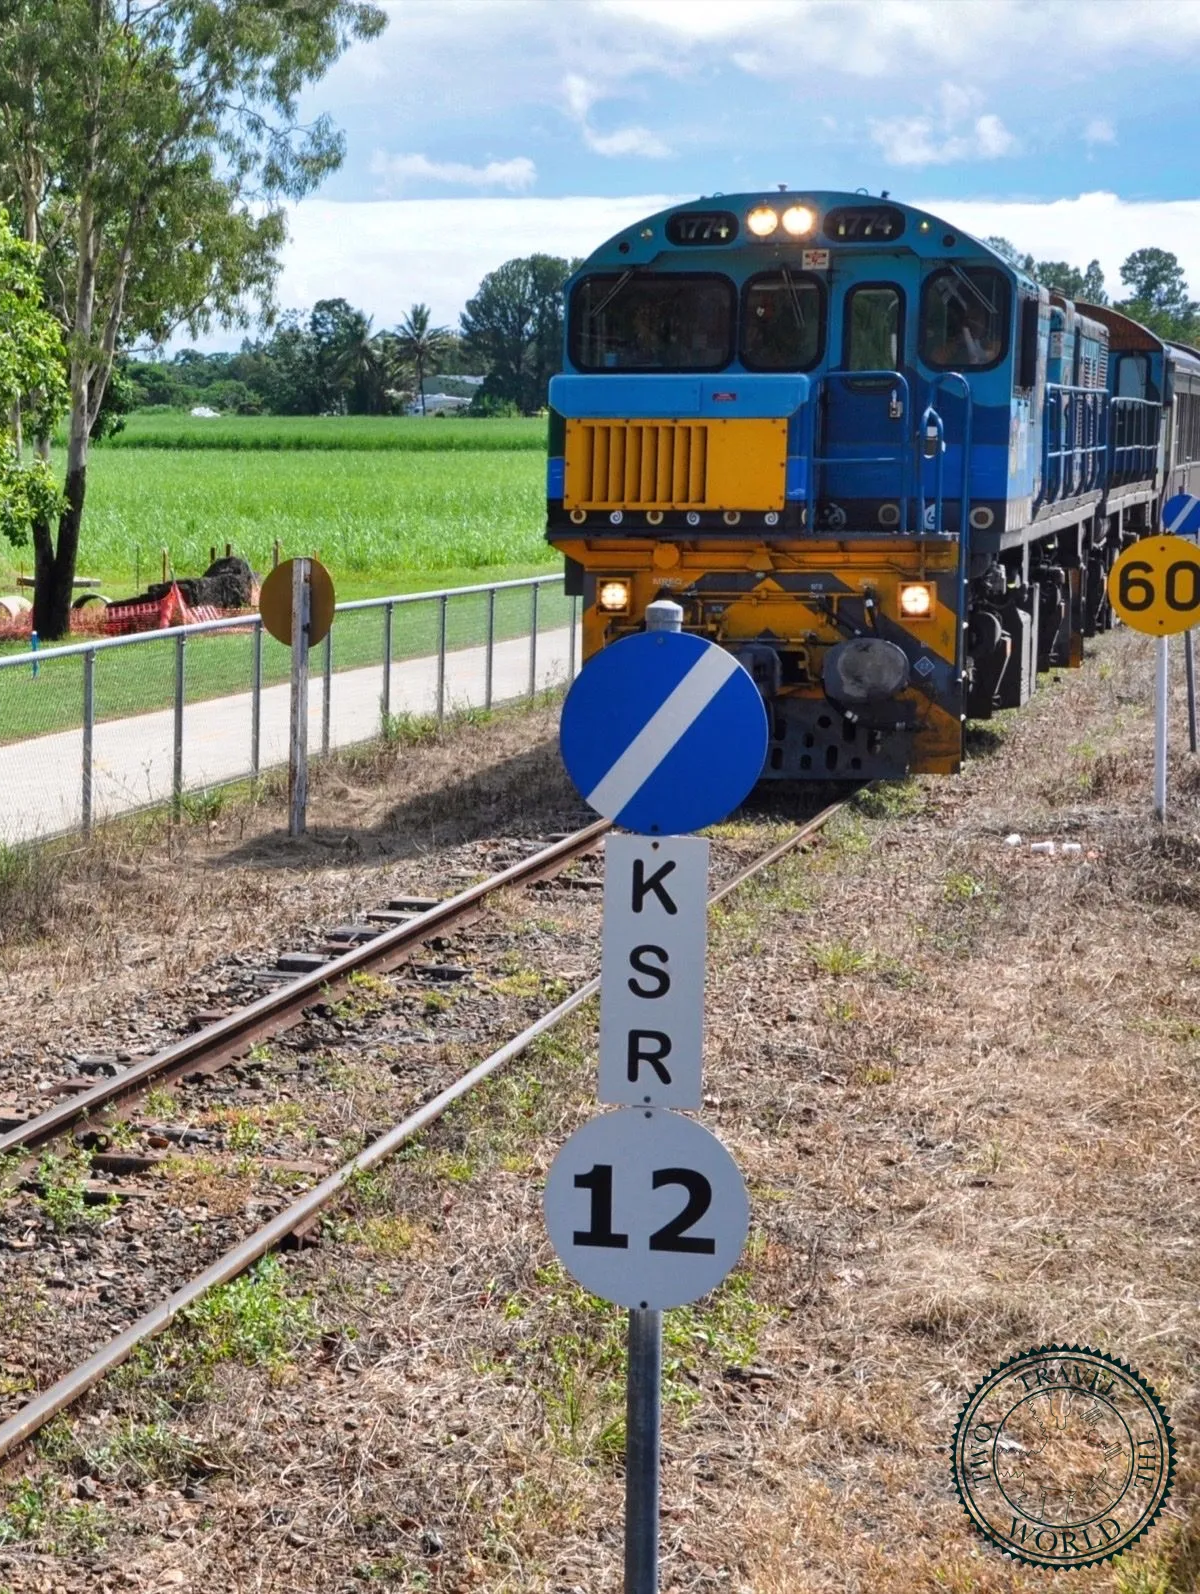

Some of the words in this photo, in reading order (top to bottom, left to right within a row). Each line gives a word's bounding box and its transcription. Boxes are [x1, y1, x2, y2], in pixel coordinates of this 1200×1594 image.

[678, 216, 730, 239] 1774
[836, 212, 893, 235] 1774
[1119, 561, 1200, 612] 60
[573, 1163, 716, 1255] 12
